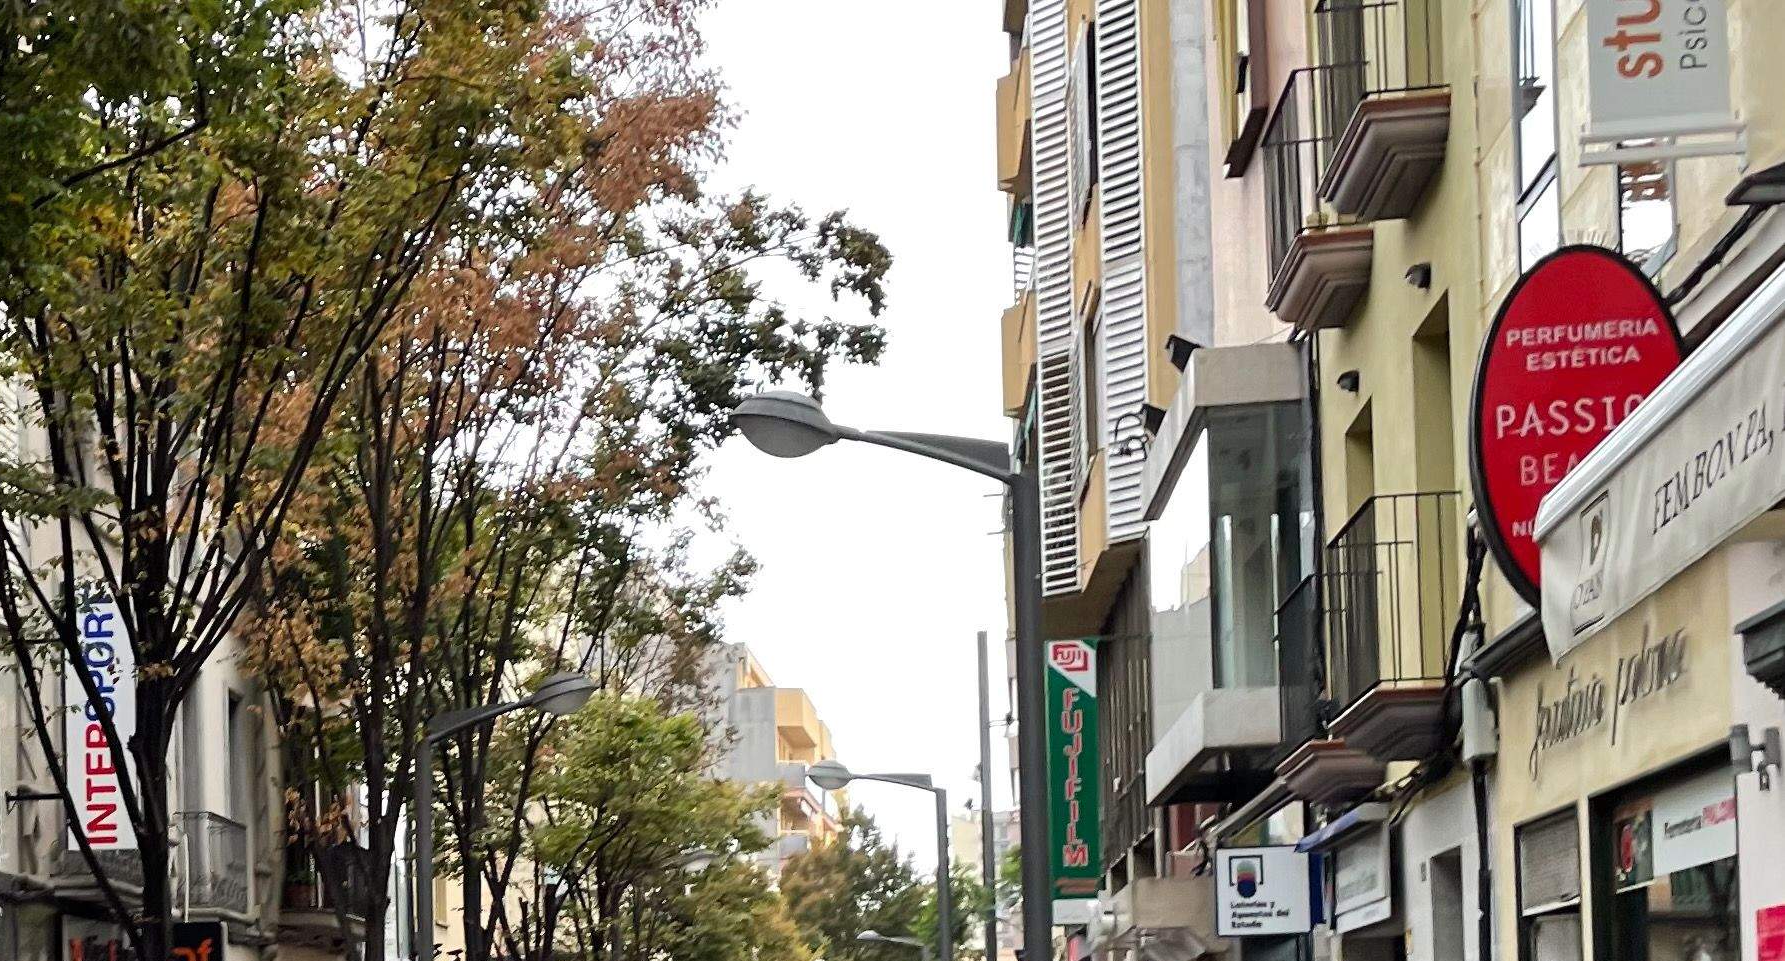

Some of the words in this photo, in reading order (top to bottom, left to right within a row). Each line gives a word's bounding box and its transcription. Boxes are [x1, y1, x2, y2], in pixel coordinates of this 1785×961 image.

[1679, 0, 1708, 71] Psic
[1506, 317, 1660, 347] PERFUMERIA
[1061, 687, 1088, 867] FUJIFILM
